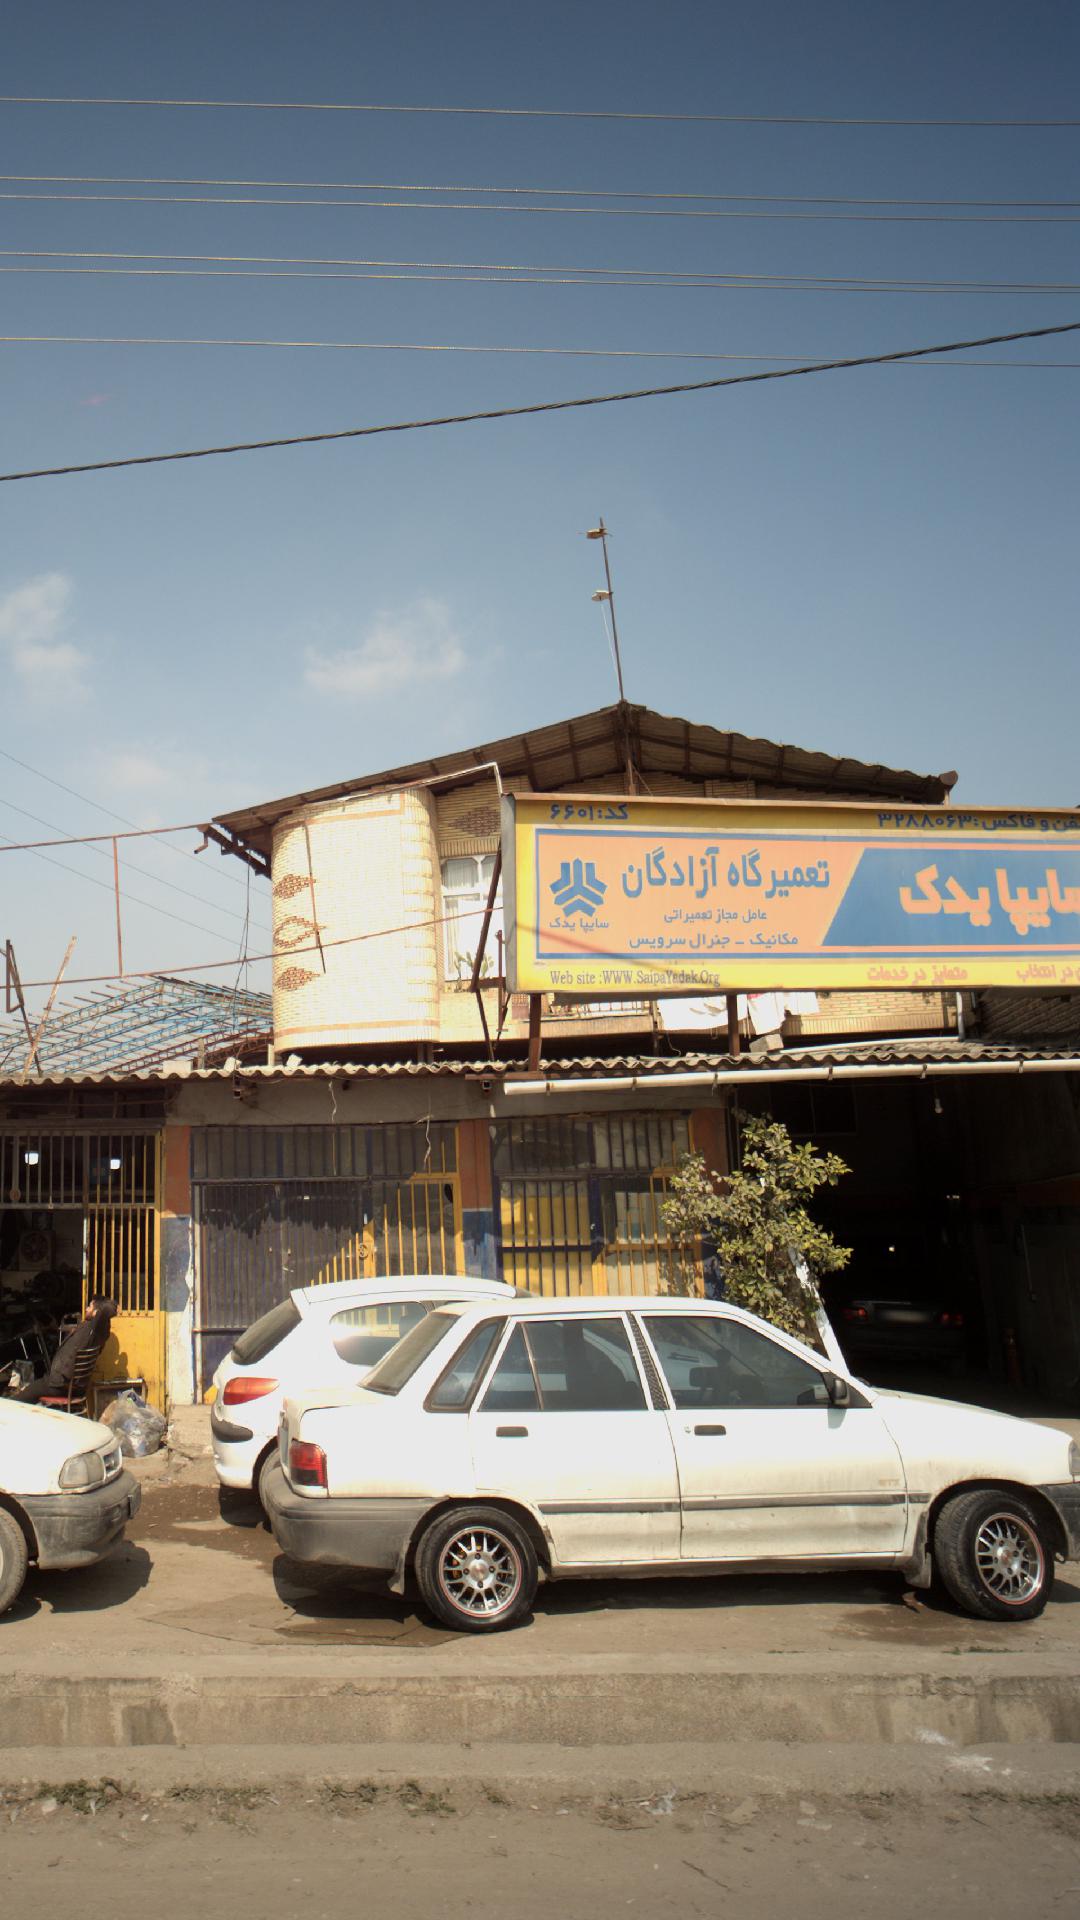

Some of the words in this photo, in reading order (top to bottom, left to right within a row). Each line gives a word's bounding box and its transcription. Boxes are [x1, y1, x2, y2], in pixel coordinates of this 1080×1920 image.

[622, 846, 720, 899] آزادگان
[727, 848, 830, 899] تعمیرگاه
[899, 863, 992, 927] یدک
[549, 916, 576, 932] یدک
[664, 908, 712, 924] تعمیراتی
[716, 908, 738, 924] مجاز
[742, 908, 767, 924] عامل
[579, 917, 609, 933] سایپا
[629, 935, 686, 949] سرویس
[689, 933, 730, 949] جنرال
[750, 932, 799, 949] مکانیک
[550, 970, 573, 985] Web
